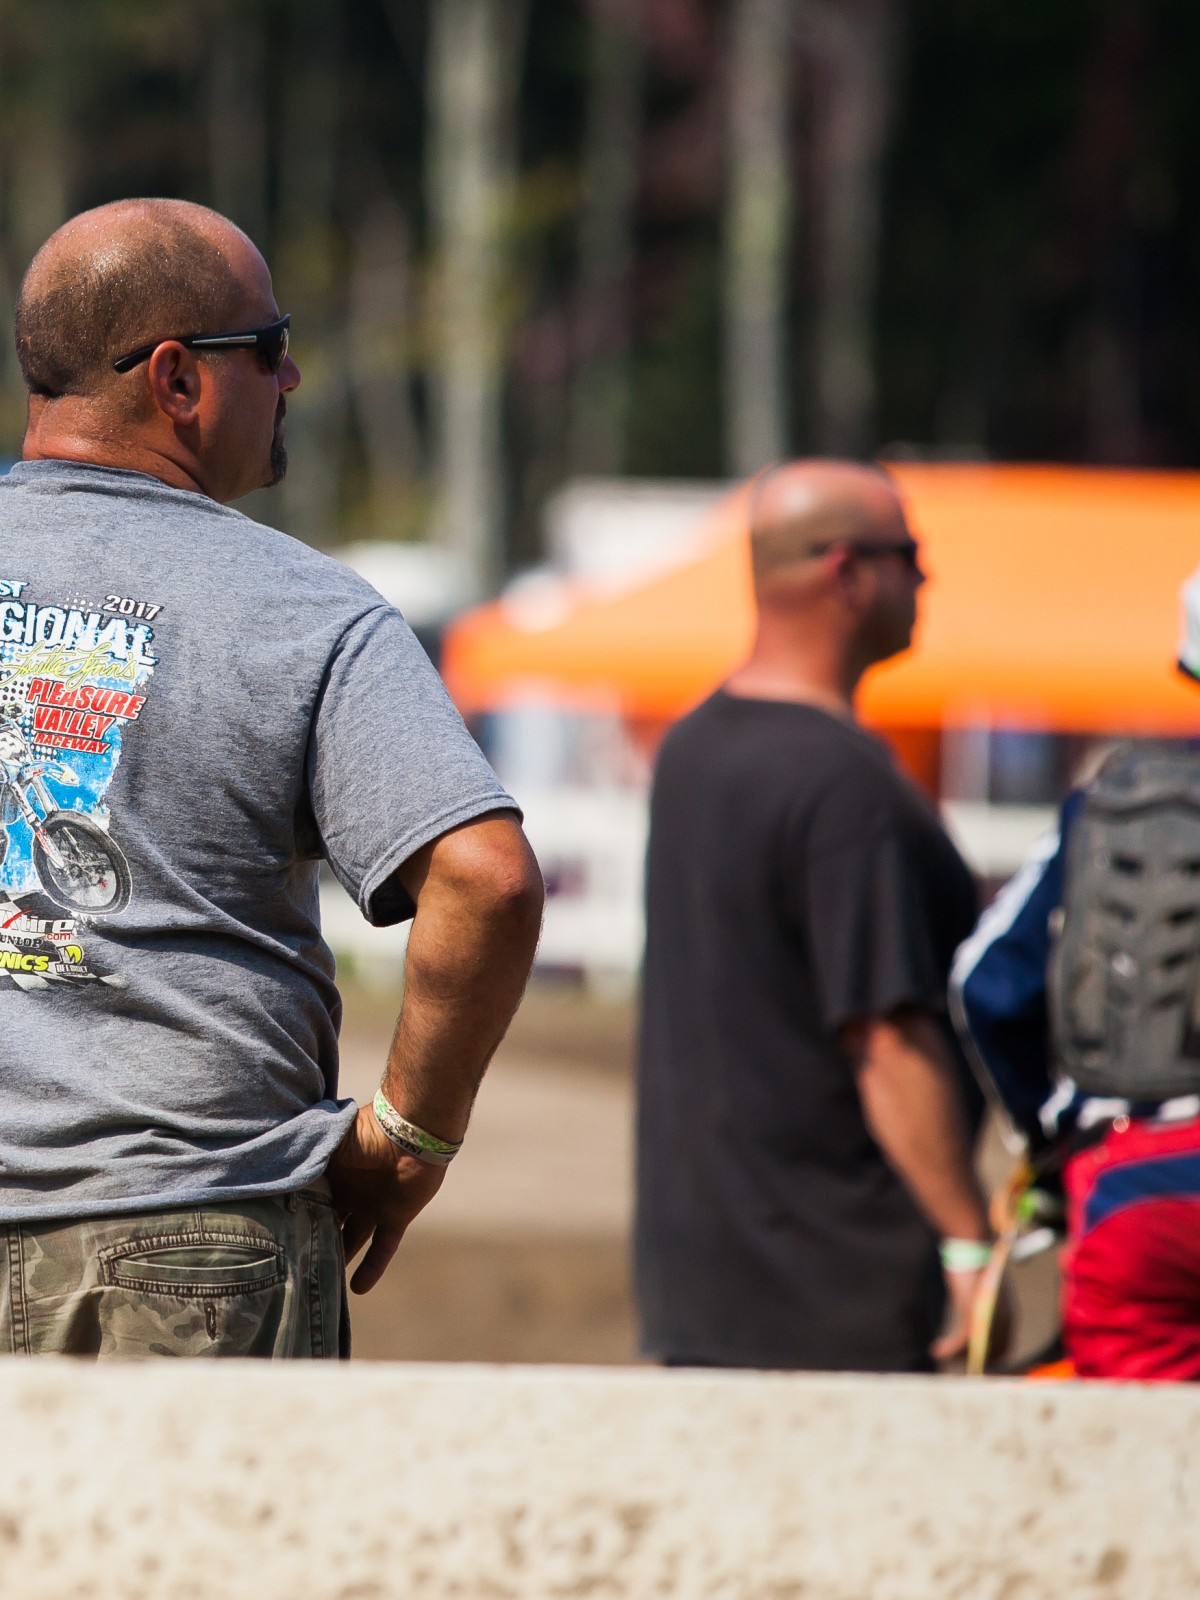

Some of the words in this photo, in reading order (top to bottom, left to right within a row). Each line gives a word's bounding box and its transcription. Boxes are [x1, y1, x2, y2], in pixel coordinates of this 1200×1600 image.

[102, 594, 164, 622] 2017
[26, 677, 148, 720] PLEASURE
[32, 705, 117, 741] VALLEY
[33, 732, 112, 755] RACEWAY
